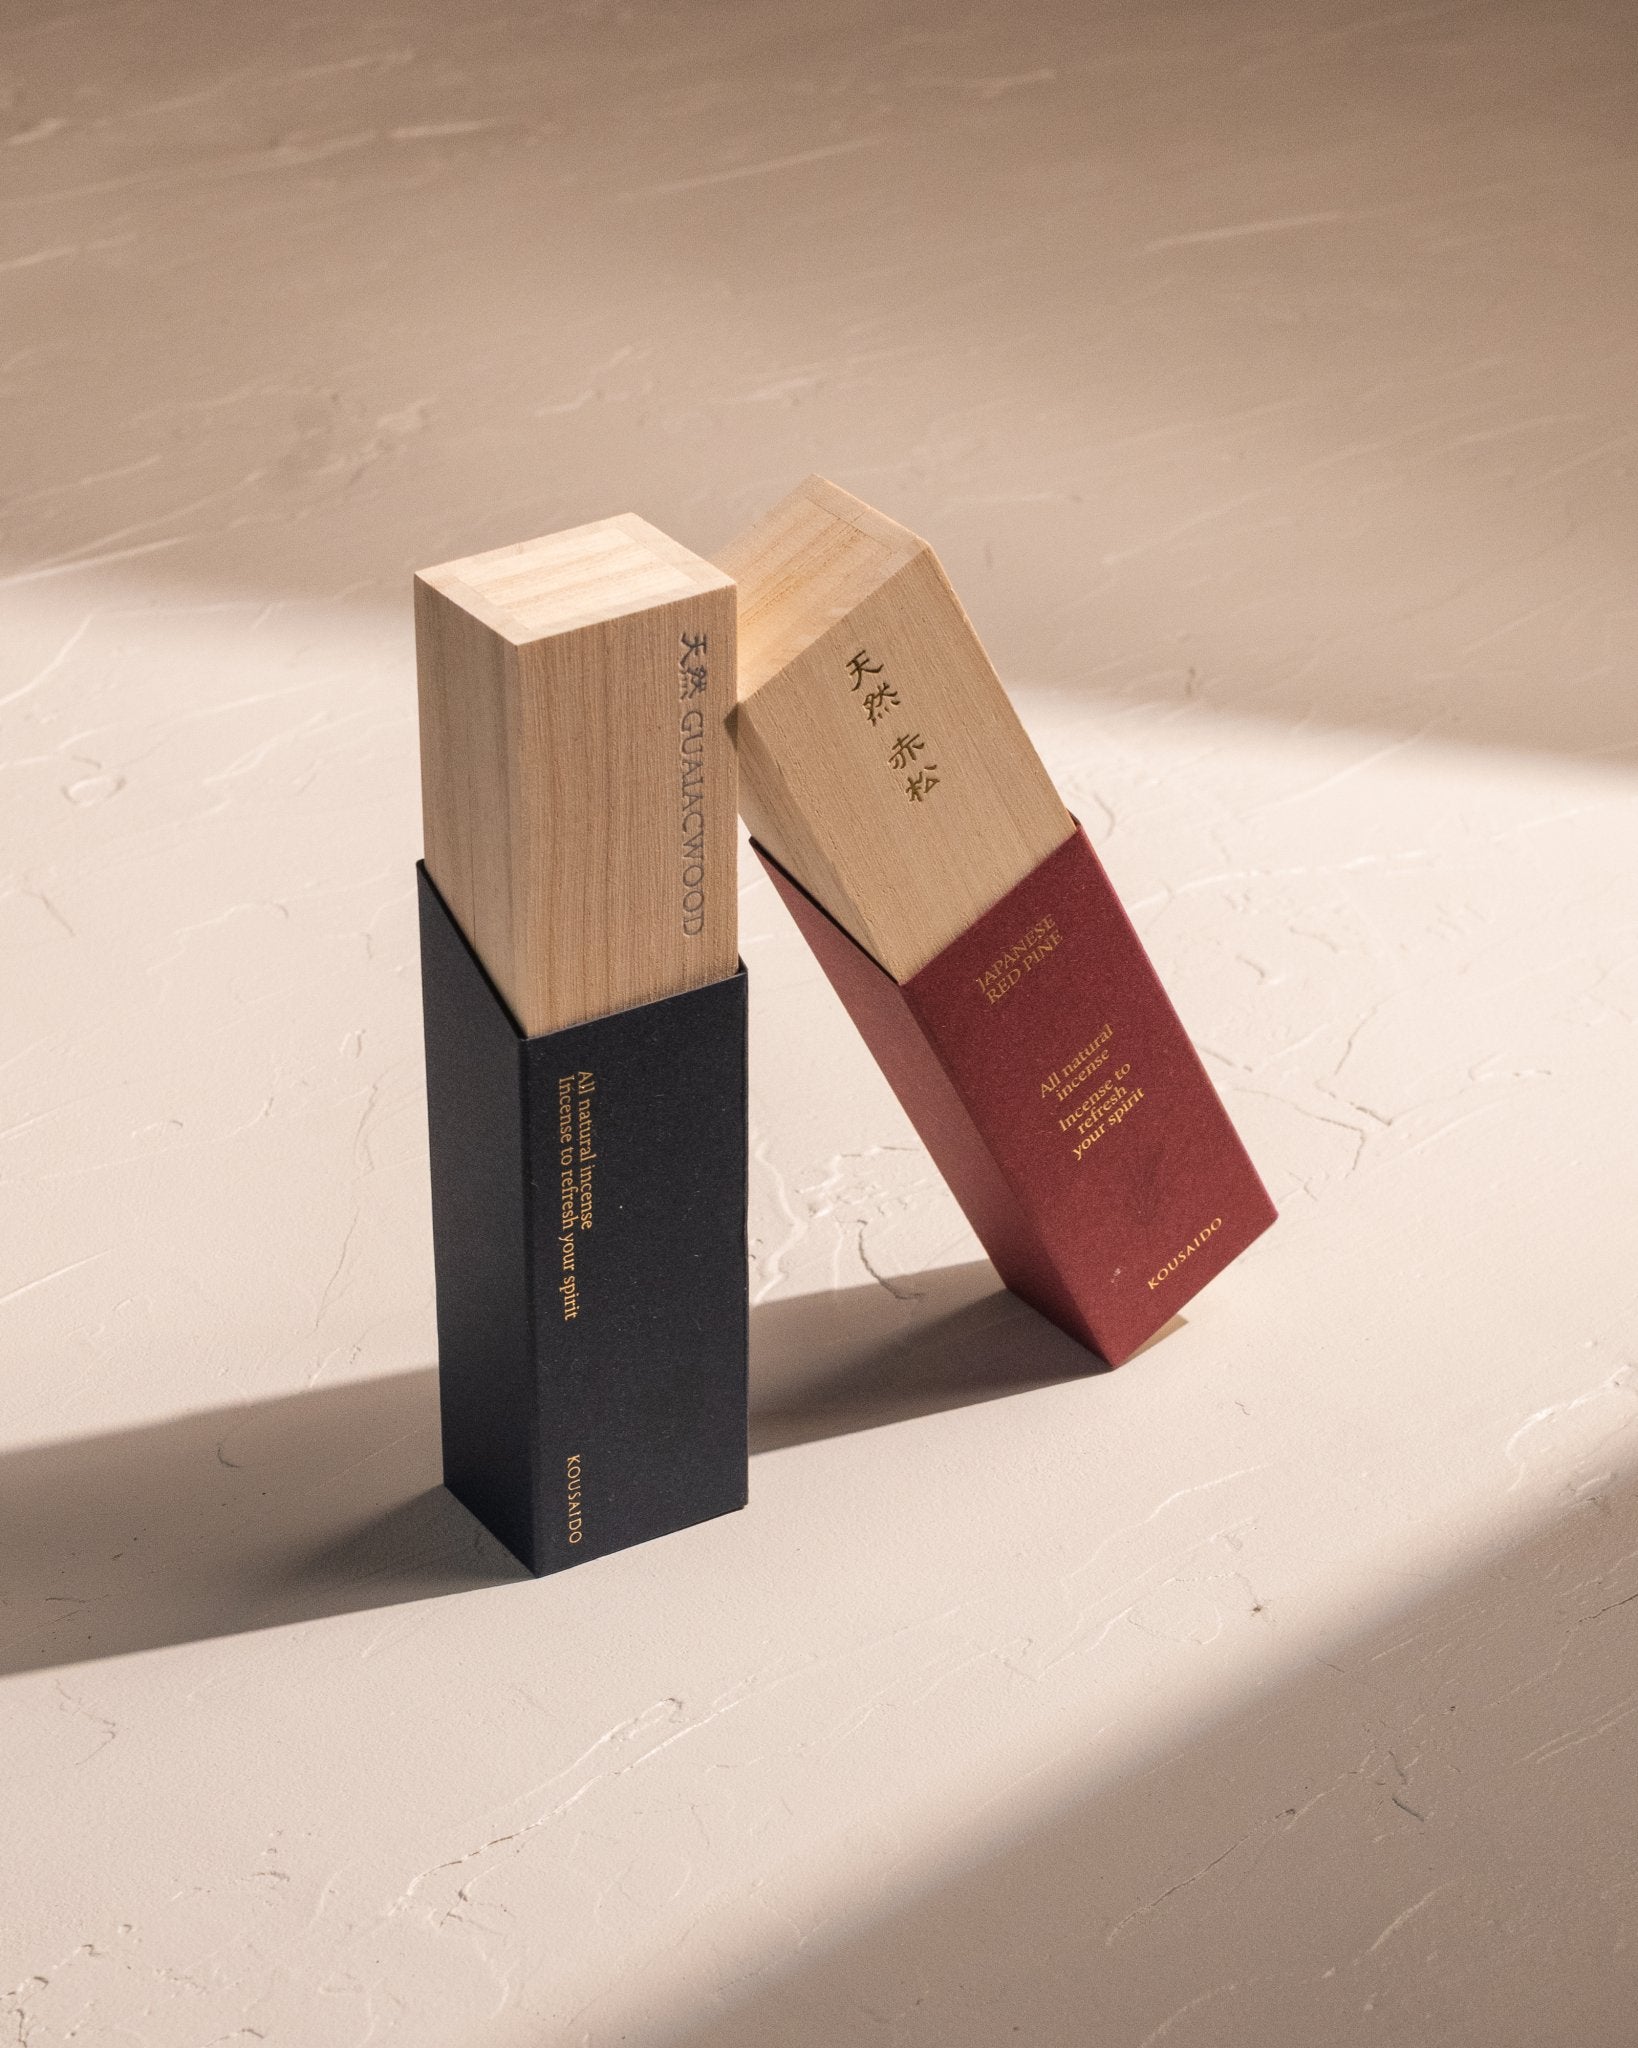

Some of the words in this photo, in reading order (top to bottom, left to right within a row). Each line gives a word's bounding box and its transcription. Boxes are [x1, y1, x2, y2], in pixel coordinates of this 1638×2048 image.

[680, 632, 707, 700] 天然
[846, 650, 901, 727] 天然
[888, 734, 940, 802] 赤松
[681, 709, 704, 937] GUAIACWOOD
[976, 914, 1056, 992] JAPANESE
[986, 968, 1021, 1004] RED
[1022, 929, 1063, 972] PINE
[578, 1071, 595, 1095] All
[1039, 1072, 1061, 1098] All
[1062, 1024, 1114, 1076] natural
[1055, 1049, 1110, 1101] incense
[559, 1075, 575, 1144] Incense
[579, 1098, 597, 1162] natural
[1058, 1078, 1114, 1132] Incense
[1114, 1063, 1131, 1081] to
[1072, 1126, 1107, 1160] your
[1108, 1087, 1145, 1126] spirit
[1077, 1085, 1127, 1134] refresh
[561, 1146, 573, 1166] to
[561, 1169, 579, 1230] refresh
[580, 1164, 596, 1230] incense
[558, 1232, 575, 1271] your
[1147, 1217, 1222, 1290] KOUSAIDO
[559, 1275, 580, 1321] spirit
[567, 1454, 582, 1543] KOUSAIDO
